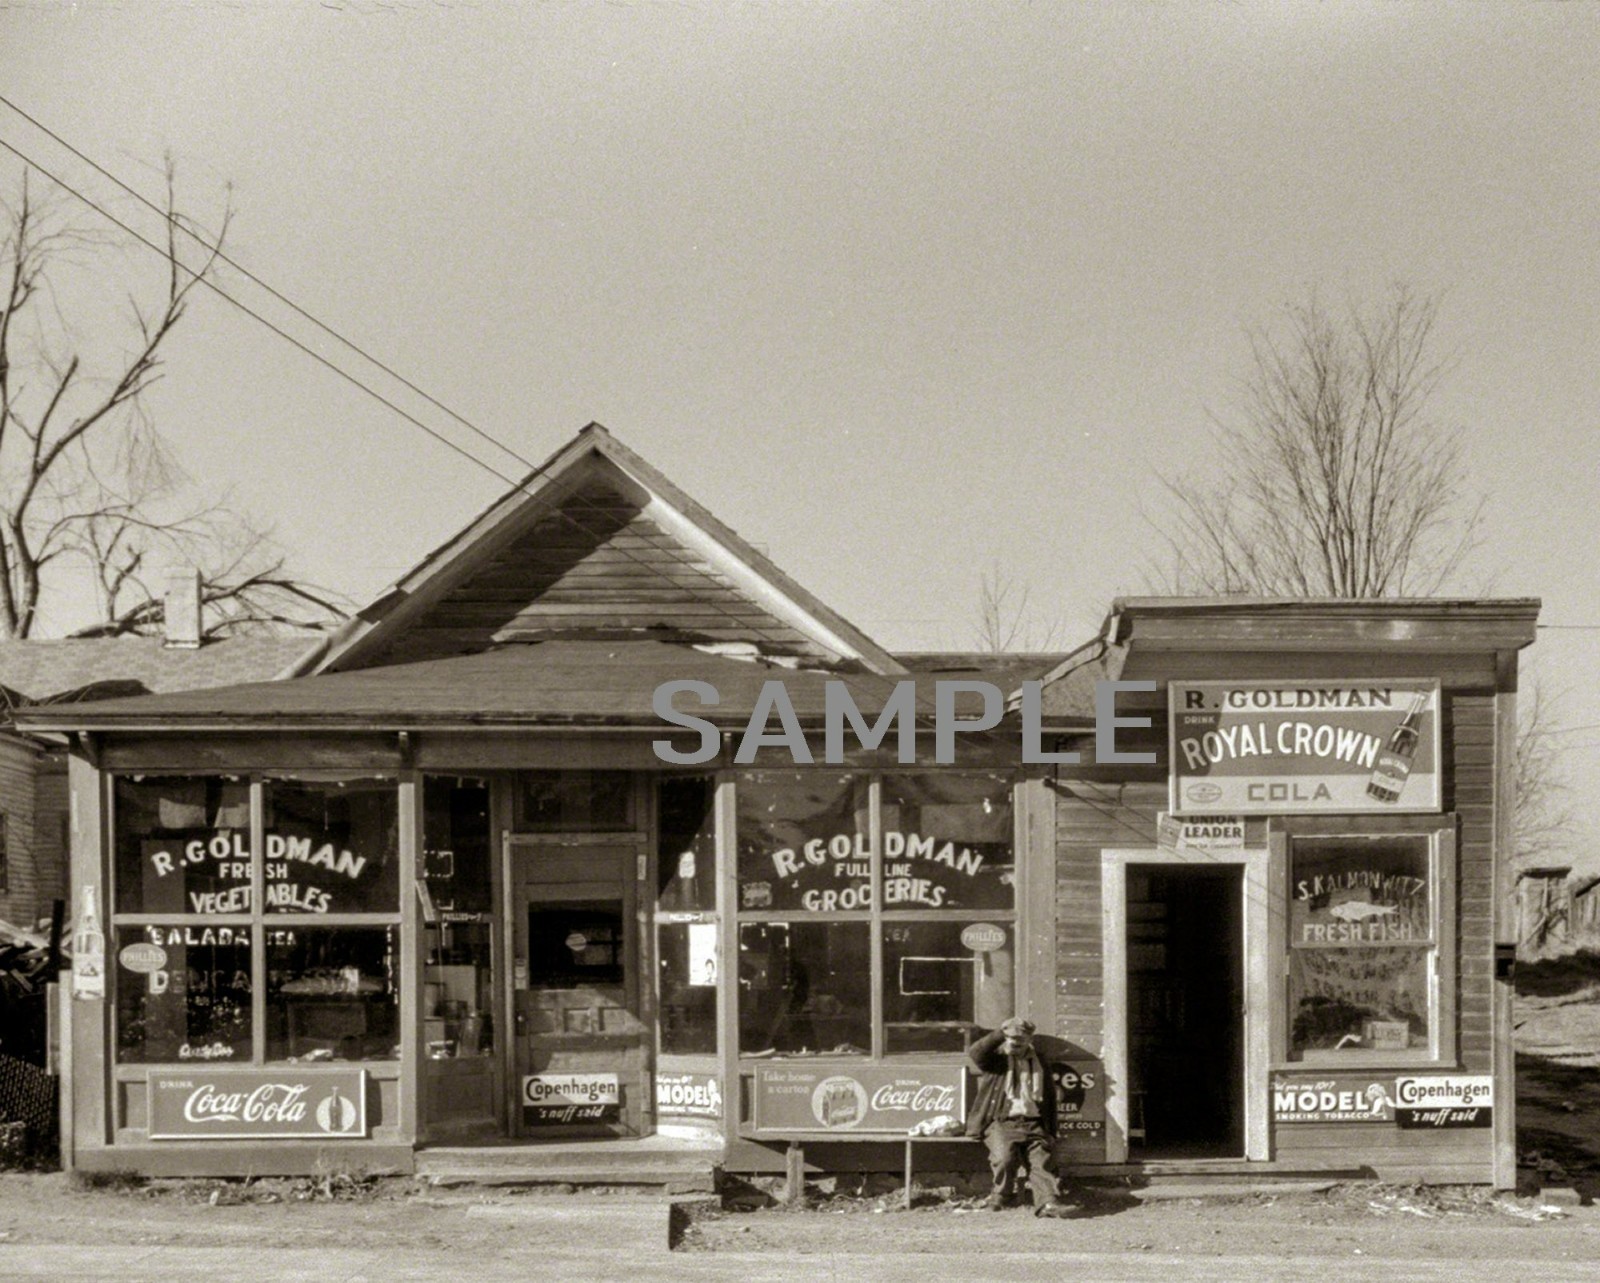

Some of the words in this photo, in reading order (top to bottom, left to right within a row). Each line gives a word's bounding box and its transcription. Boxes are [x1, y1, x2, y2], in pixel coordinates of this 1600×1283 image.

[1228, 688, 1392, 708] GOLDMAN
[1184, 716, 1215, 724] DRINK
[1180, 722, 1273, 770] ROYAL
[1276, 721, 1381, 769] CROWN
[1247, 783, 1333, 801] COLA
[1190, 815, 1237, 824] UNION
[1185, 827, 1242, 838] LEADER
[219, 862, 288, 878] FRESH
[834, 863, 871, 877] FULL
[884, 863, 912, 877] LINE
[189, 883, 333, 914] VEGETABLES
[802, 878, 947, 911] GROCERIES
[151, 927, 249, 946] SALADA
[1303, 922, 1362, 942] FRESH
[1369, 922, 1412, 942] FISH
[159, 1081, 194, 1089] DRINK
[762, 1071, 786, 1081] Take
[526, 1077, 616, 1101] Copenhagen
[656, 1085, 710, 1105] MODEL
[776, 1085, 810, 1094] carton
[871, 1084, 956, 1111] Coca-Cola
[1398, 1079, 1490, 1103] Copenhagen
[184, 1083, 312, 1123] Coca-Cola
[1057, 1103, 1077, 1111] EER
[1274, 1091, 1369, 1112] MODEL
[549, 1105, 577, 1122] nuff
[577, 1105, 605, 1117] said
[1422, 1109, 1451, 1125] nuff
[1450, 1108, 1478, 1121] said
